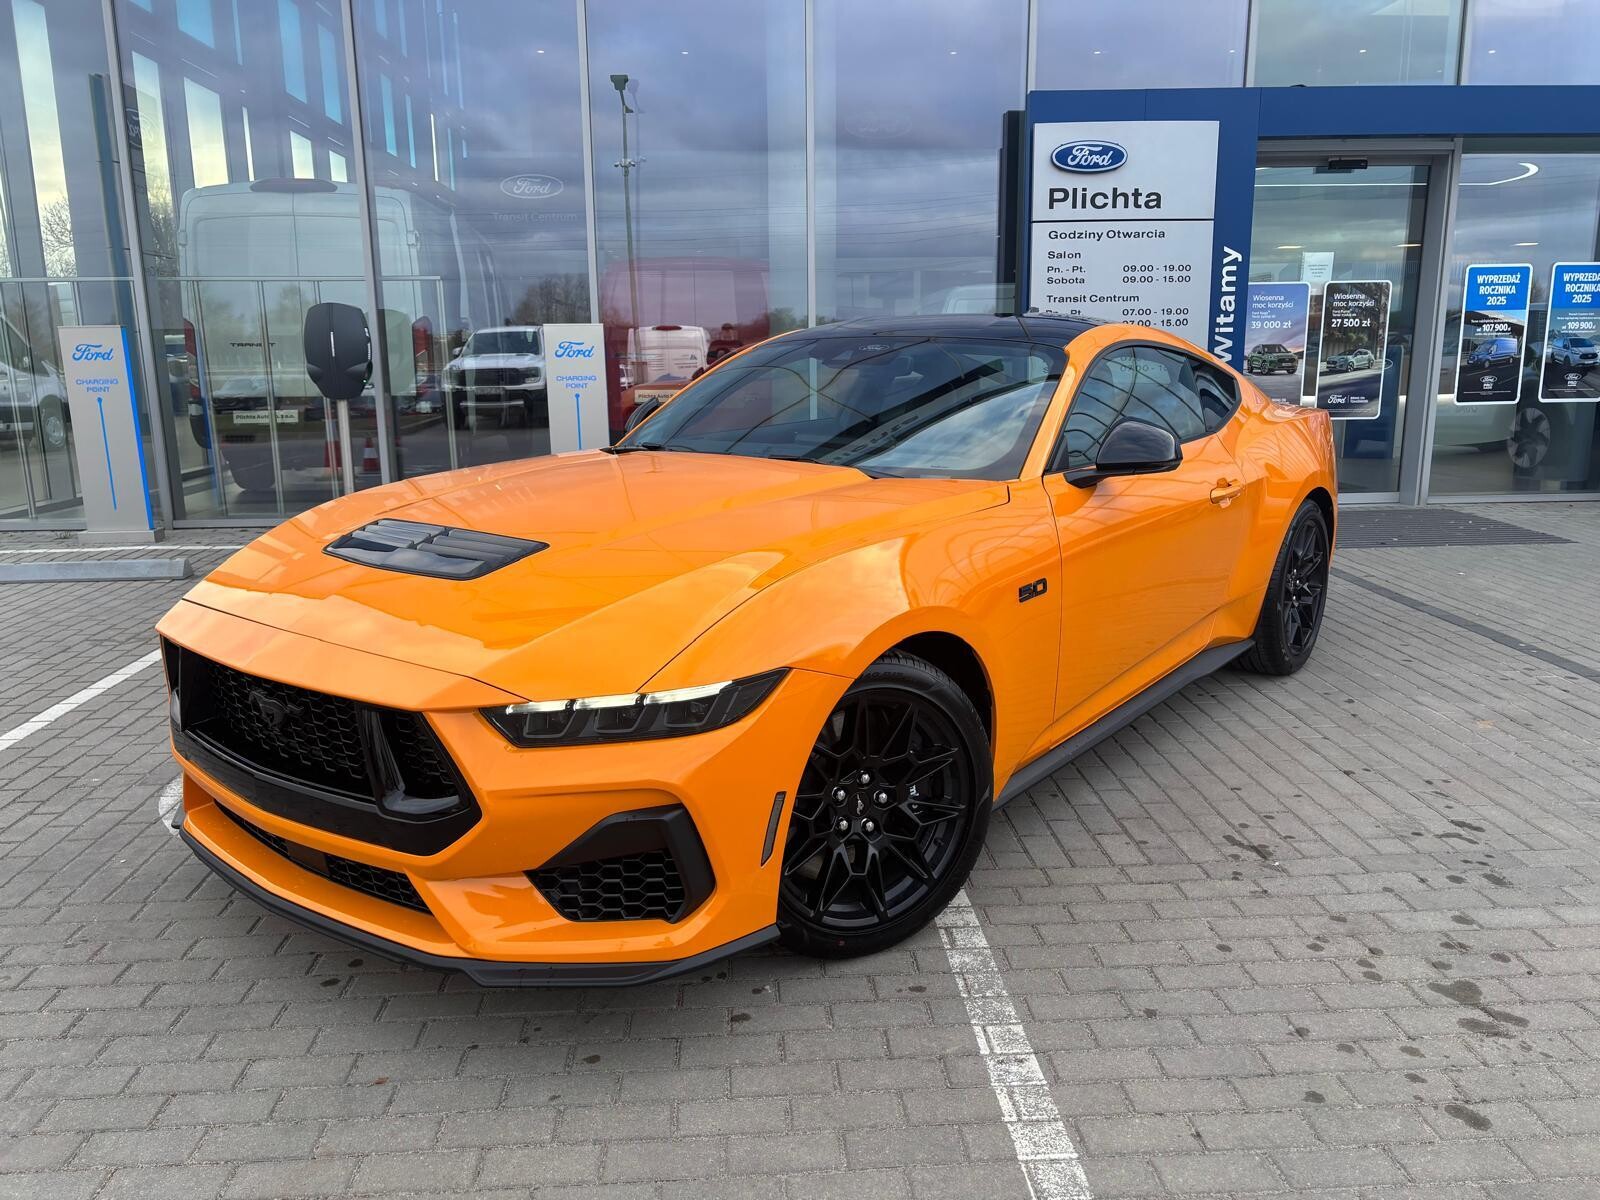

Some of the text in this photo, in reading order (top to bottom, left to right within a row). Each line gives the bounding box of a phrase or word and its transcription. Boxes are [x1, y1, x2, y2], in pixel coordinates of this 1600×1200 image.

[1068, 146, 1113, 166] Ford
[513, 178, 552, 194] Ford
[1048, 187, 1162, 210] Plichta
[1048, 229, 1165, 241] Godziny Otwarcia
[1048, 251, 1081, 259] Salon
[1047, 276, 1085, 284] Sobota
[1477, 273, 1520, 284] WYPRZEDAŻ
[1479, 286, 1516, 295] ROCZNIKA
[1047, 294, 1139, 303] Transit Centrum
[1487, 296, 1506, 305] 2025
[1572, 294, 1592, 303] 2025
[1212, 246, 1242, 362] witamy
[1268, 301, 1294, 309] korzyści
[1348, 300, 1375, 308] korzyści
[1283, 320, 1292, 328] zł
[1332, 318, 1371, 327] 27 500 zł
[72, 344, 113, 360] Ford
[555, 341, 594, 357] Ford
[1328, 395, 1346, 403] Ford
